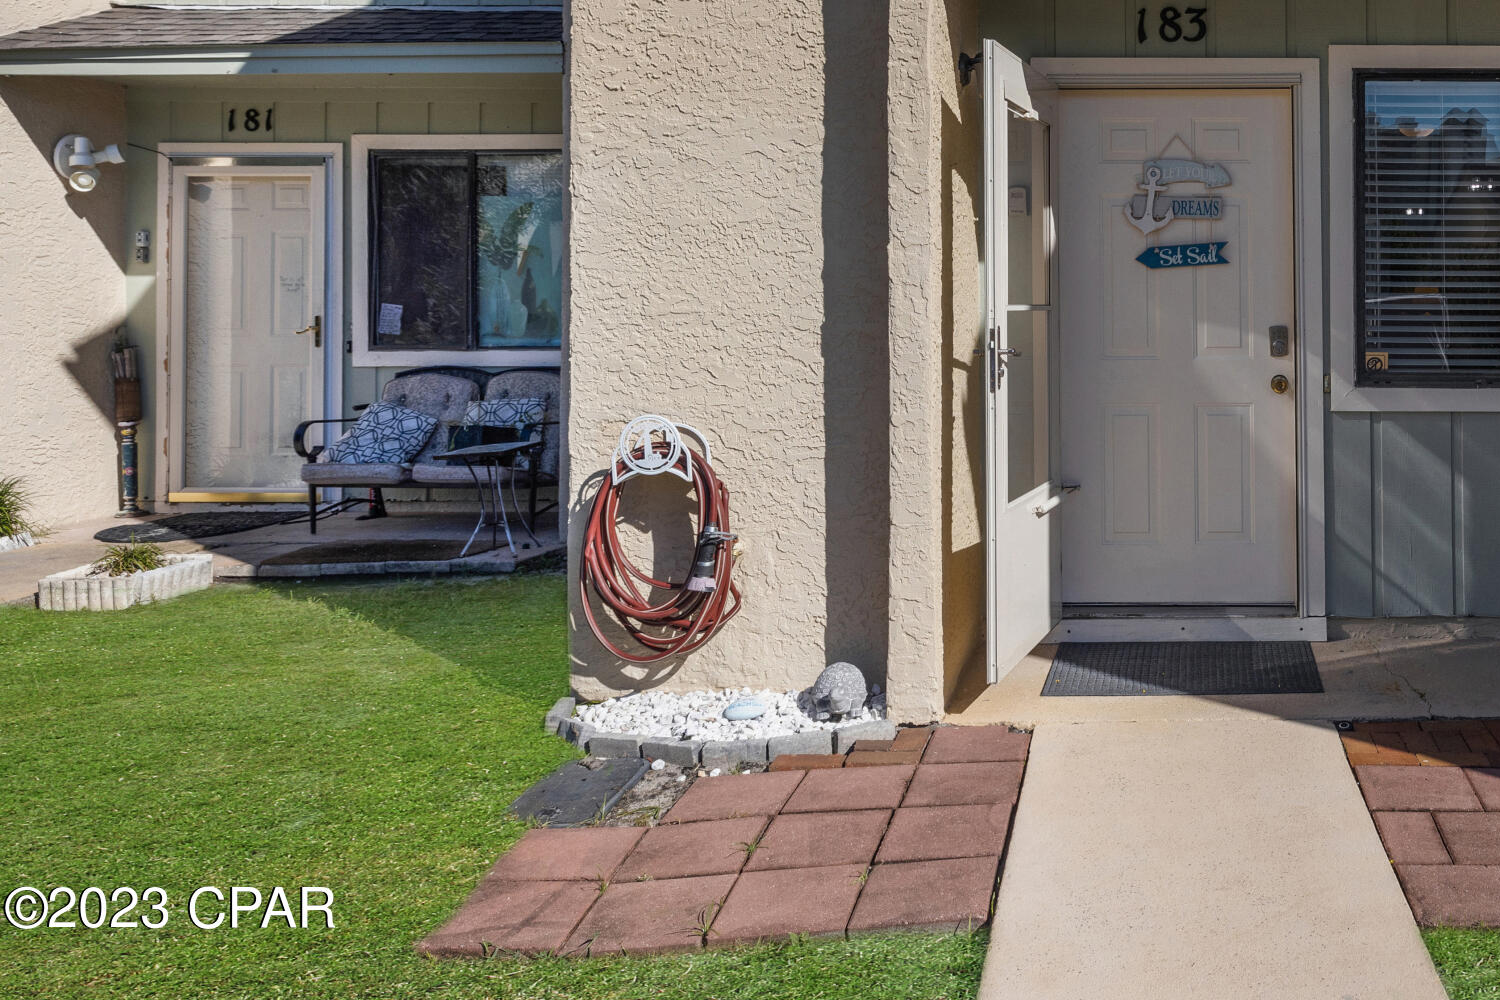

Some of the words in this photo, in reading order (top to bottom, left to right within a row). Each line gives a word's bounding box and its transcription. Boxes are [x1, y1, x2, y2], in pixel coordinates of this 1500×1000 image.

[1137, 6, 1207, 44] 183
[228, 108, 272, 132] 181
[1162, 167, 1183, 179] LET
[1172, 200, 1219, 217] DREAMS
[1159, 248, 1184, 266] Set
[1187, 245, 1218, 265] Sail
